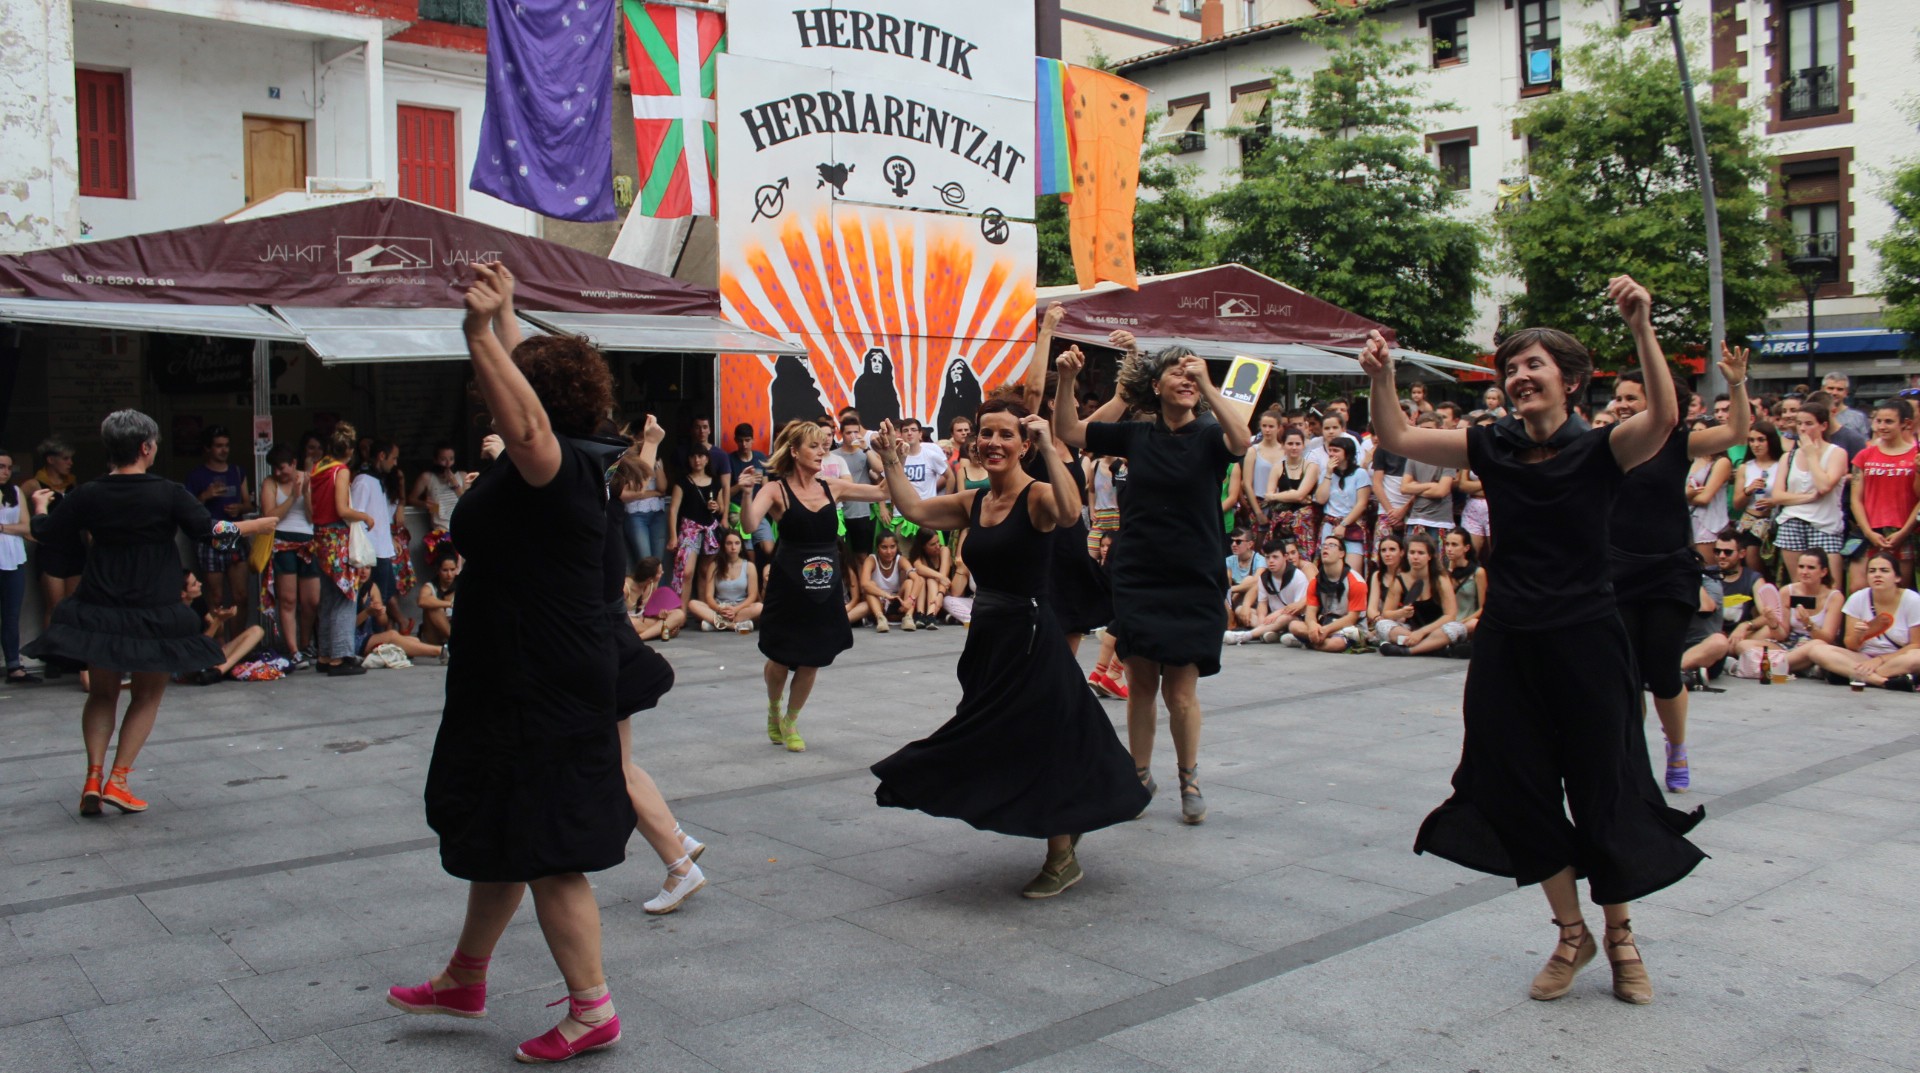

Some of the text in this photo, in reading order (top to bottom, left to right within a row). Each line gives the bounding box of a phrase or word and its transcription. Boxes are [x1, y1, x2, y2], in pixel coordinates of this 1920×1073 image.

[792, 8, 978, 80] HERRITIK
[740, 90, 1026, 184] HERRIARENTZAT
[258, 245, 326, 263] JAI-KIT
[442, 249, 502, 266] JAI-KIT
[62, 273, 82, 284] tel.
[85, 275, 103, 285] 94
[137, 277, 154, 286] 02
[1177, 296, 1210, 310] JAI-KIT
[1263, 304, 1292, 317] JAI-KIT
[1234, 392, 1252, 402] xabi
[1864, 467, 1912, 478] FRUITY
